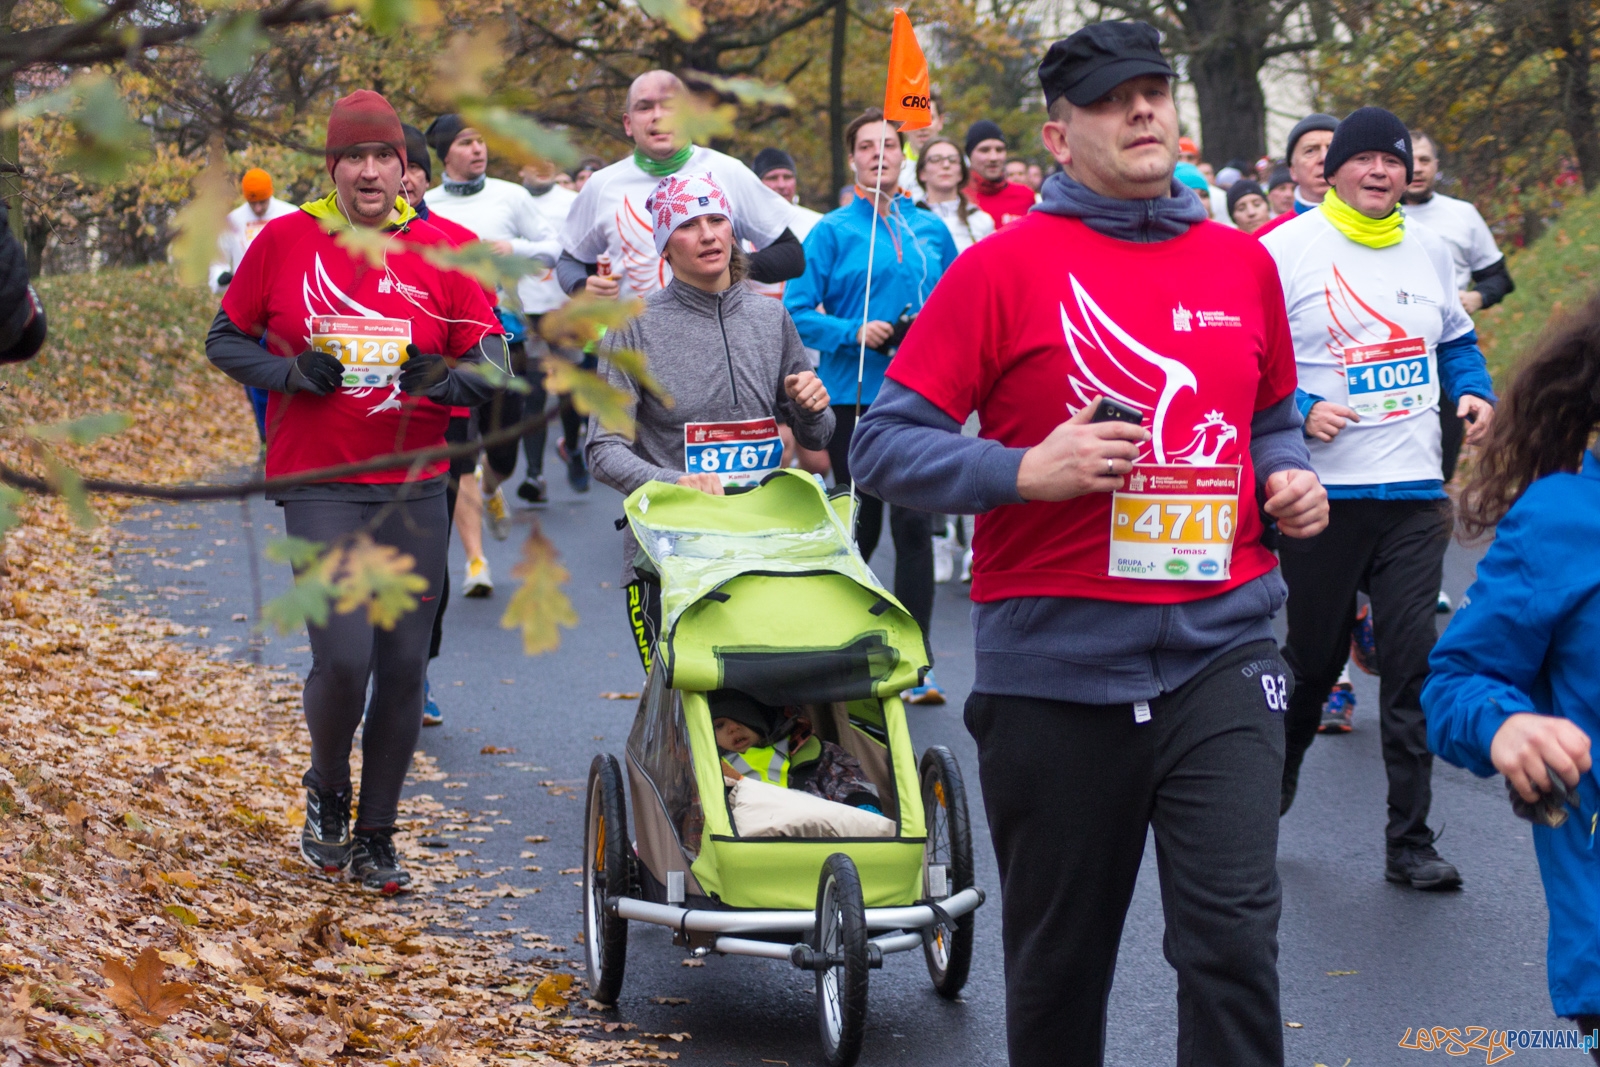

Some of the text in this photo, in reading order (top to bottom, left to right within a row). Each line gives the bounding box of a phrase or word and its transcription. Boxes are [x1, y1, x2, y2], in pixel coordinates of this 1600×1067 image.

[325, 340, 400, 364] 3126
[1349, 361, 1424, 390] E 1002
[689, 443, 775, 472] E 8767
[1150, 475, 1157, 489] 1
[1196, 478, 1235, 489] RunPoland.org
[1117, 504, 1232, 540] D 4716
[1171, 547, 1207, 555] Tomasz
[1117, 558, 1142, 566] GRUPA
[1117, 565, 1147, 574] LUXMED
